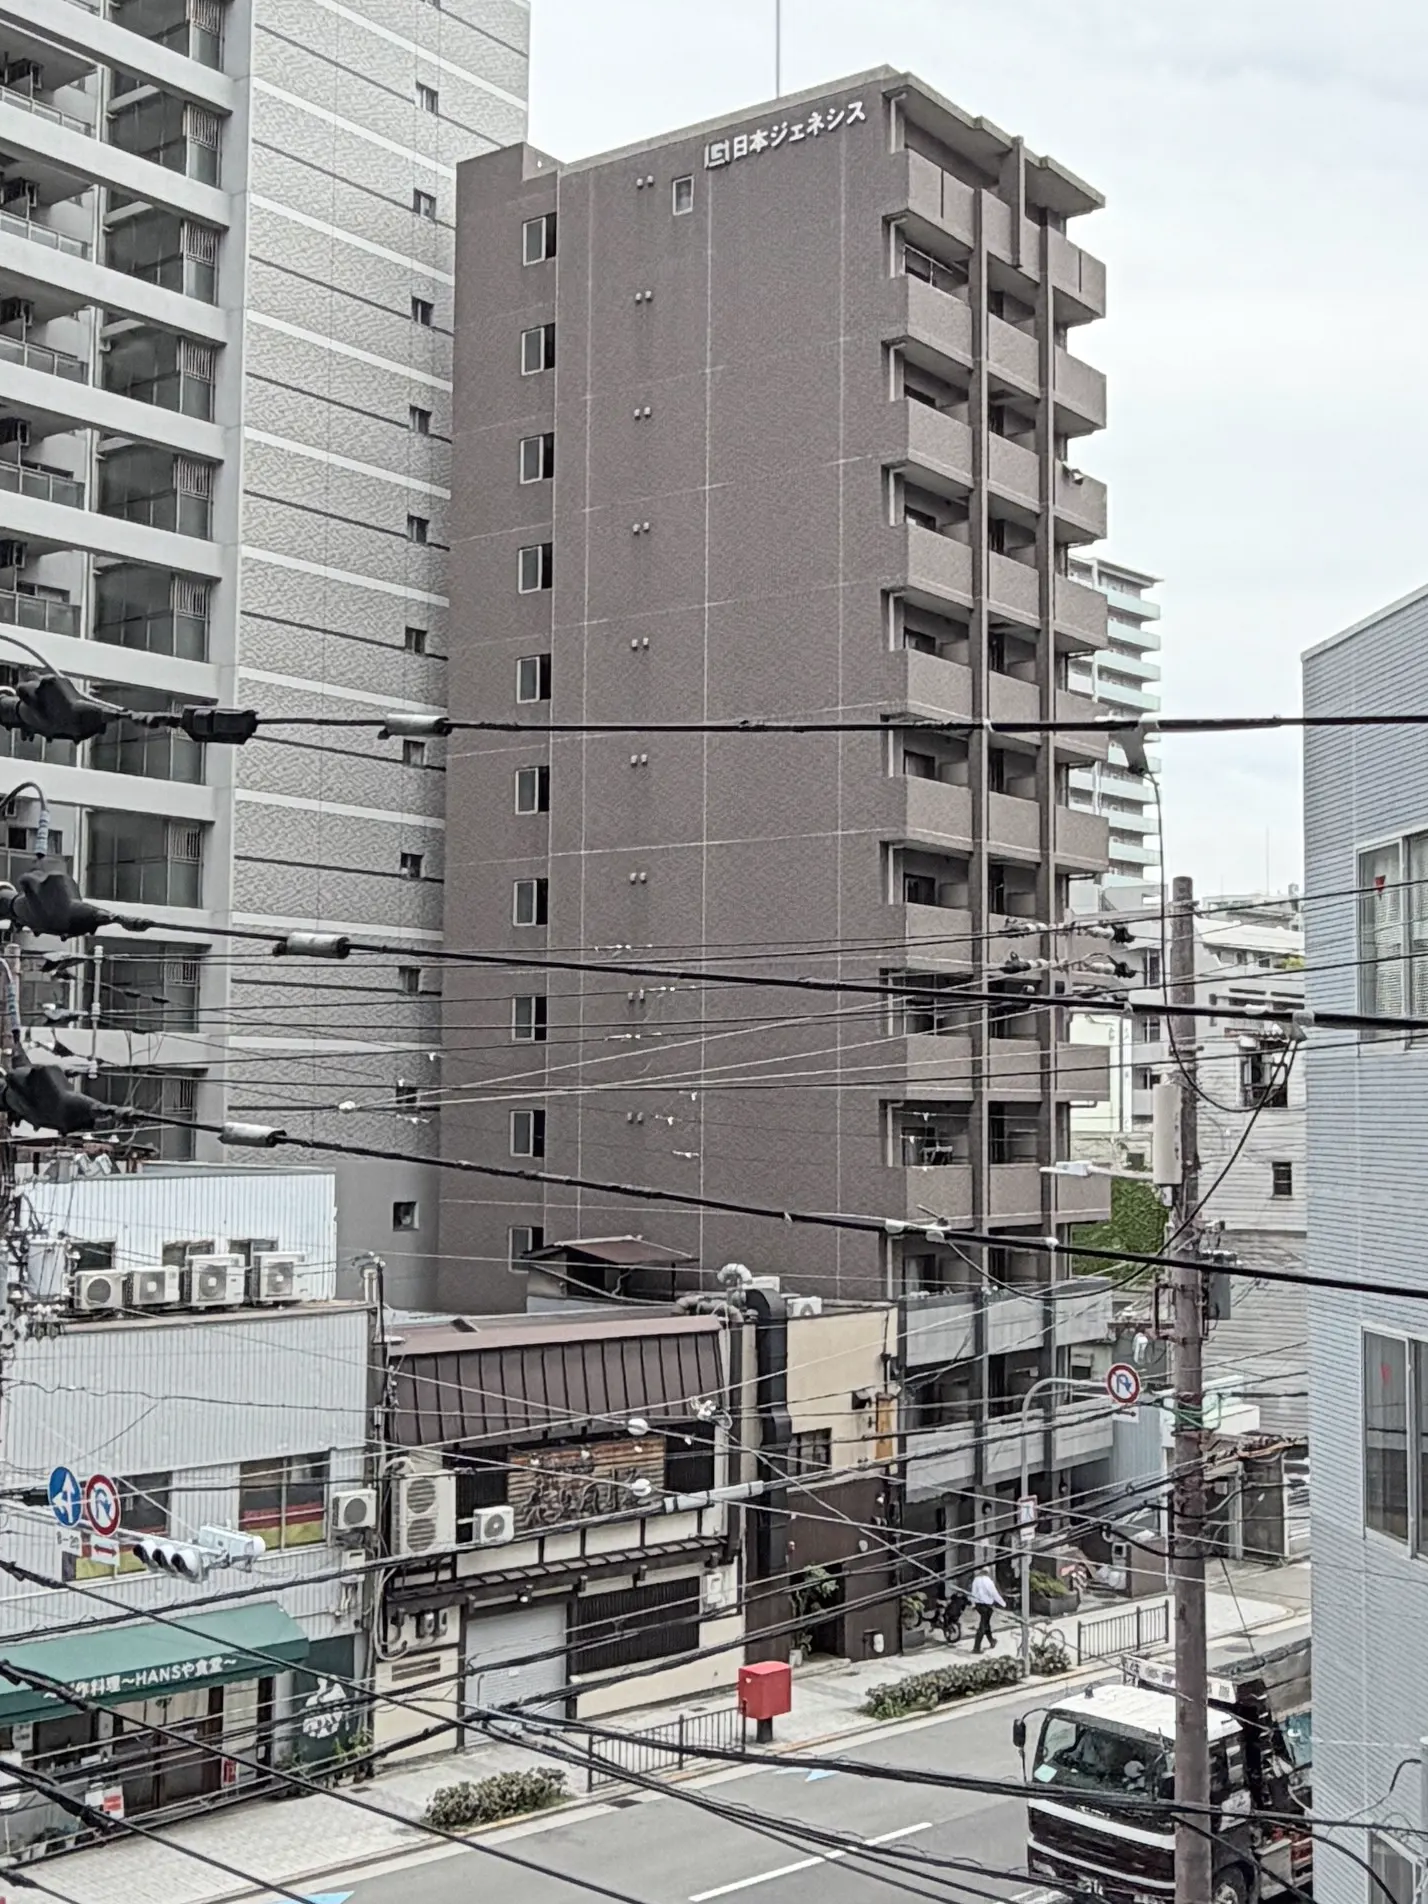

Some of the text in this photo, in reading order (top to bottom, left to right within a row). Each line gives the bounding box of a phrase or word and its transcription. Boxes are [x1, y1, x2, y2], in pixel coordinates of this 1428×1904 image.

[732, 100, 867, 161] 日本ジェネシス
